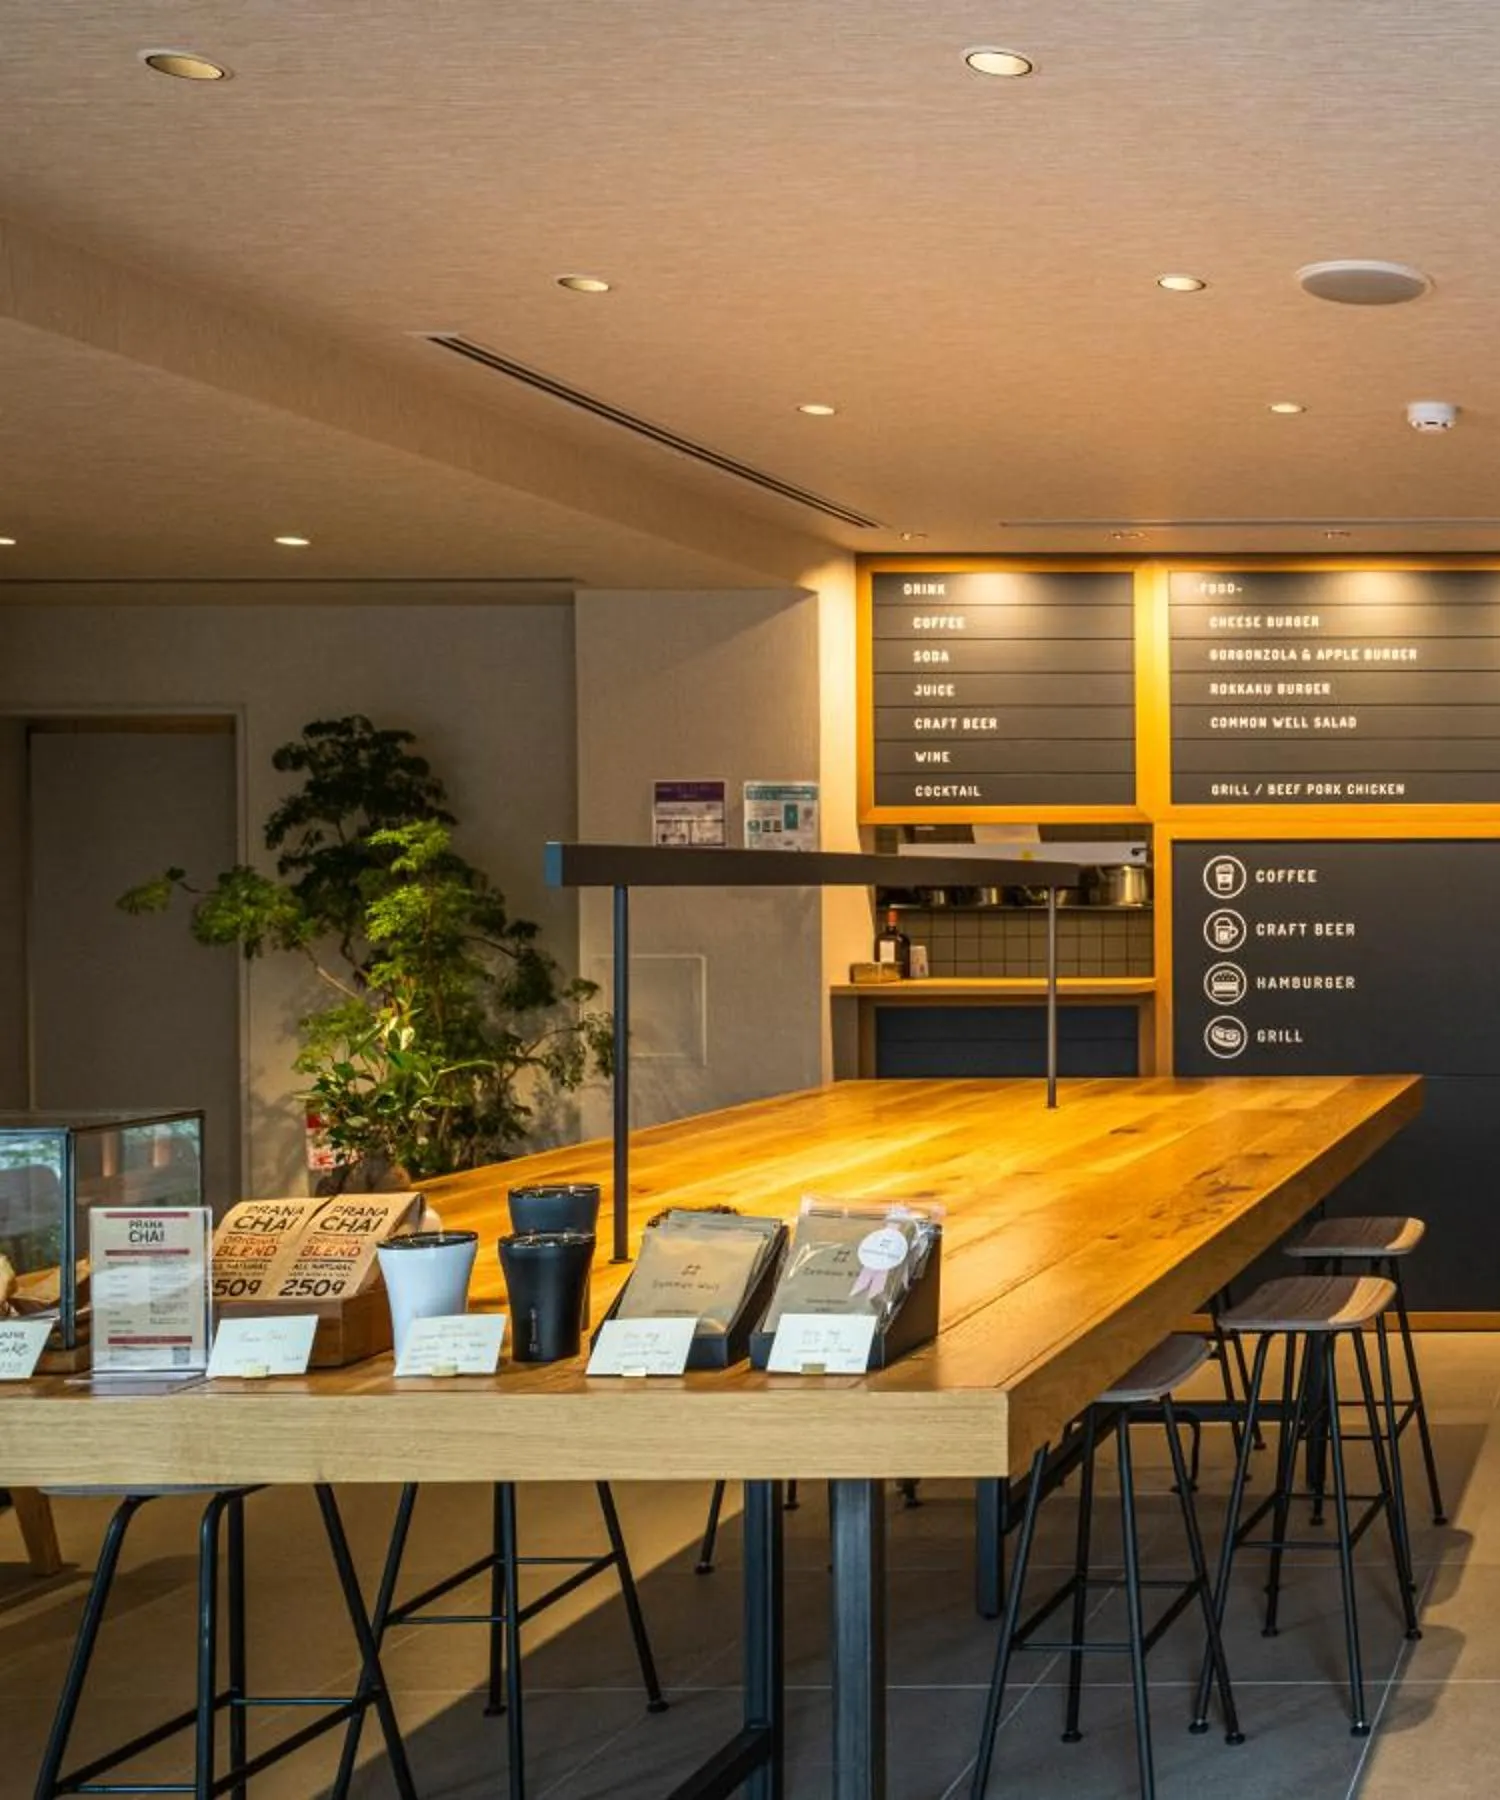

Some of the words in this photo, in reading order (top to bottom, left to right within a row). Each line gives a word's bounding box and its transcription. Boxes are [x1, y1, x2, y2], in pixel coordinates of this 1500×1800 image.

[903, 583, 945, 595] DRINK
[912, 616, 964, 629] COFFEE
[1209, 615, 1261, 628] CHEESE
[1266, 615, 1320, 628] BURGER
[913, 650, 950, 662] SODA
[1209, 648, 1298, 661] GORGONZOLA
[1316, 648, 1360, 661] APPLE
[1364, 648, 1418, 661] BURGER
[913, 684, 955, 696] JUICE
[1209, 682, 1273, 695] ROKKAKU
[1277, 682, 1331, 695] BURGER
[913, 717, 958, 730] CRAFT
[962, 717, 998, 730] BEER
[1210, 716, 1267, 729] COMMON
[1272, 716, 1309, 729] WELL
[1313, 716, 1357, 729] SALAD
[914, 751, 950, 763] WINE
[914, 784, 981, 797] COCKTAIL
[1211, 783, 1250, 796] GRILL
[1254, 783, 1263, 796] /
[1267, 783, 1301, 796] BEEF
[1306, 783, 1342, 796] PORK
[1346, 783, 1405, 796] CHICKEN
[1255, 869, 1318, 884] COFFEE
[1255, 922, 1308, 937] CRAFT
[1314, 922, 1356, 937] BEER
[1256, 975, 1356, 990] HAMBURGER
[1256, 1029, 1304, 1043] GRILL
[246, 1205, 305, 1216] PRANA
[332, 1205, 389, 1216] PRANA
[232, 1215, 300, 1232] CHAI
[320, 1215, 384, 1232] CHAI
[128, 1230, 165, 1243] CHAI
[215, 1245, 278, 1257] BLEND
[301, 1245, 362, 1257] BLEND
[211, 1279, 263, 1297] 50g
[278, 1279, 347, 1297] 250g
